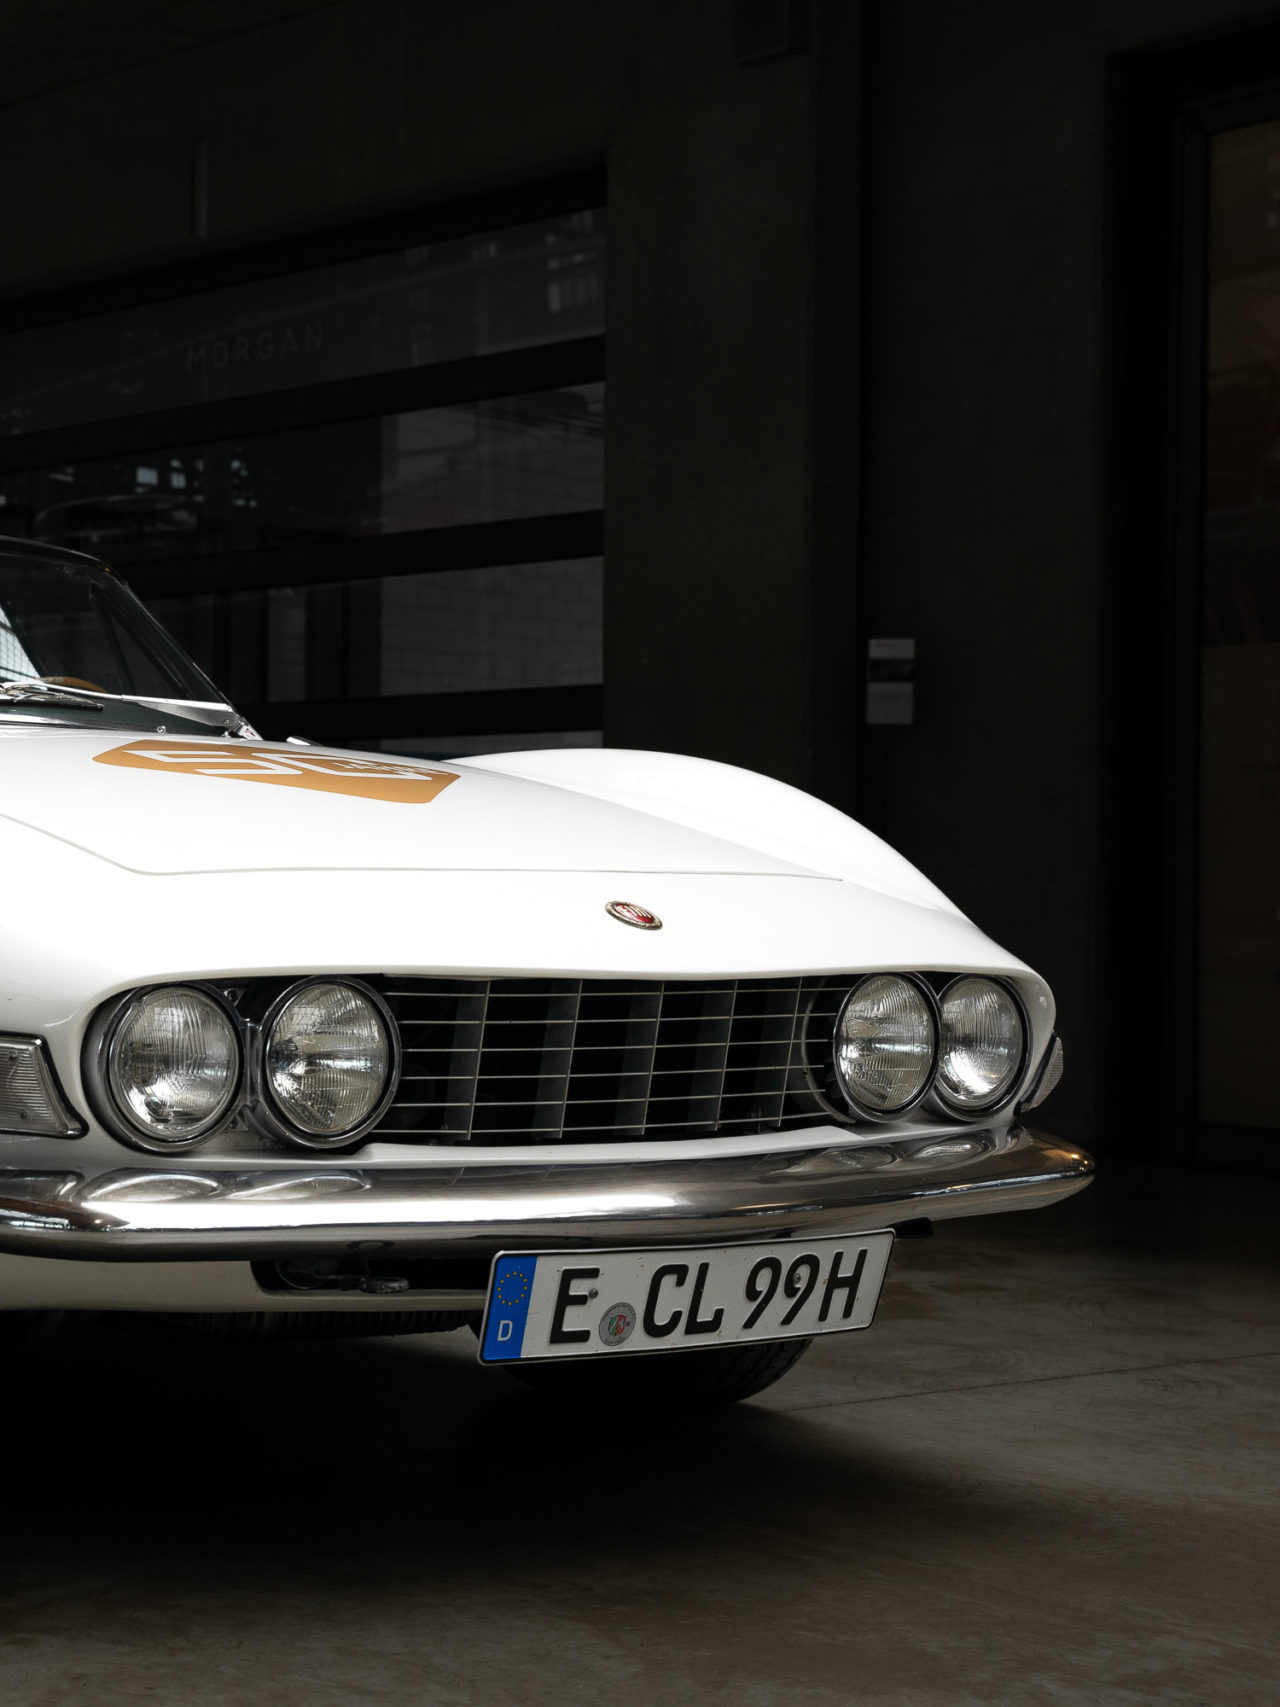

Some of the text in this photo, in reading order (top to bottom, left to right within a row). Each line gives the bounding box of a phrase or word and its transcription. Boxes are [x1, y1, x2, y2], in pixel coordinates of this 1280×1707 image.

[187, 320, 322, 376] MORGAN
[549, 1266, 601, 1345] E
[642, 1261, 725, 1338] CL
[742, 1248, 868, 1330] 99H
[497, 1319, 513, 1342] D
